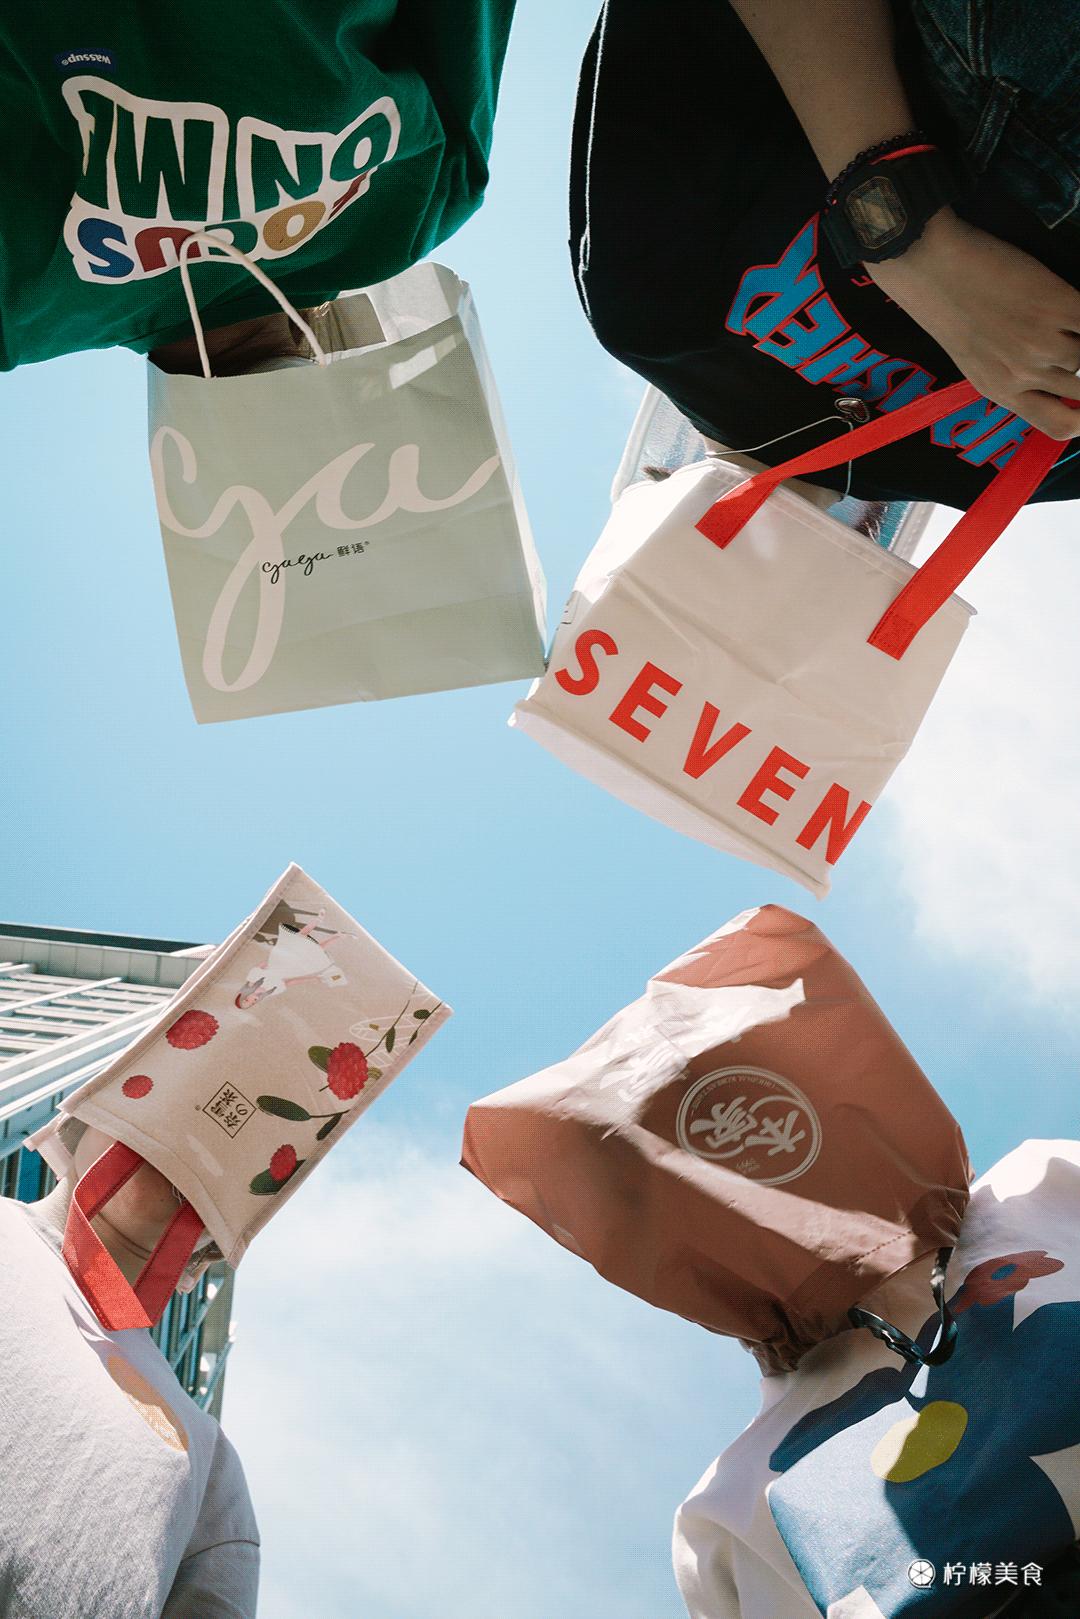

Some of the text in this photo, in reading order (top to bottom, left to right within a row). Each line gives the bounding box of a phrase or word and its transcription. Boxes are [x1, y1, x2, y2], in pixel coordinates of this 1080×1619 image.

[252, 112, 391, 214] ON
[725, 212, 1034, 470] HRASHER
[262, 543, 365, 584] gaga 鲜语
[555, 629, 872, 866] SEVEN
[690, 1096, 806, 1156] 本家
